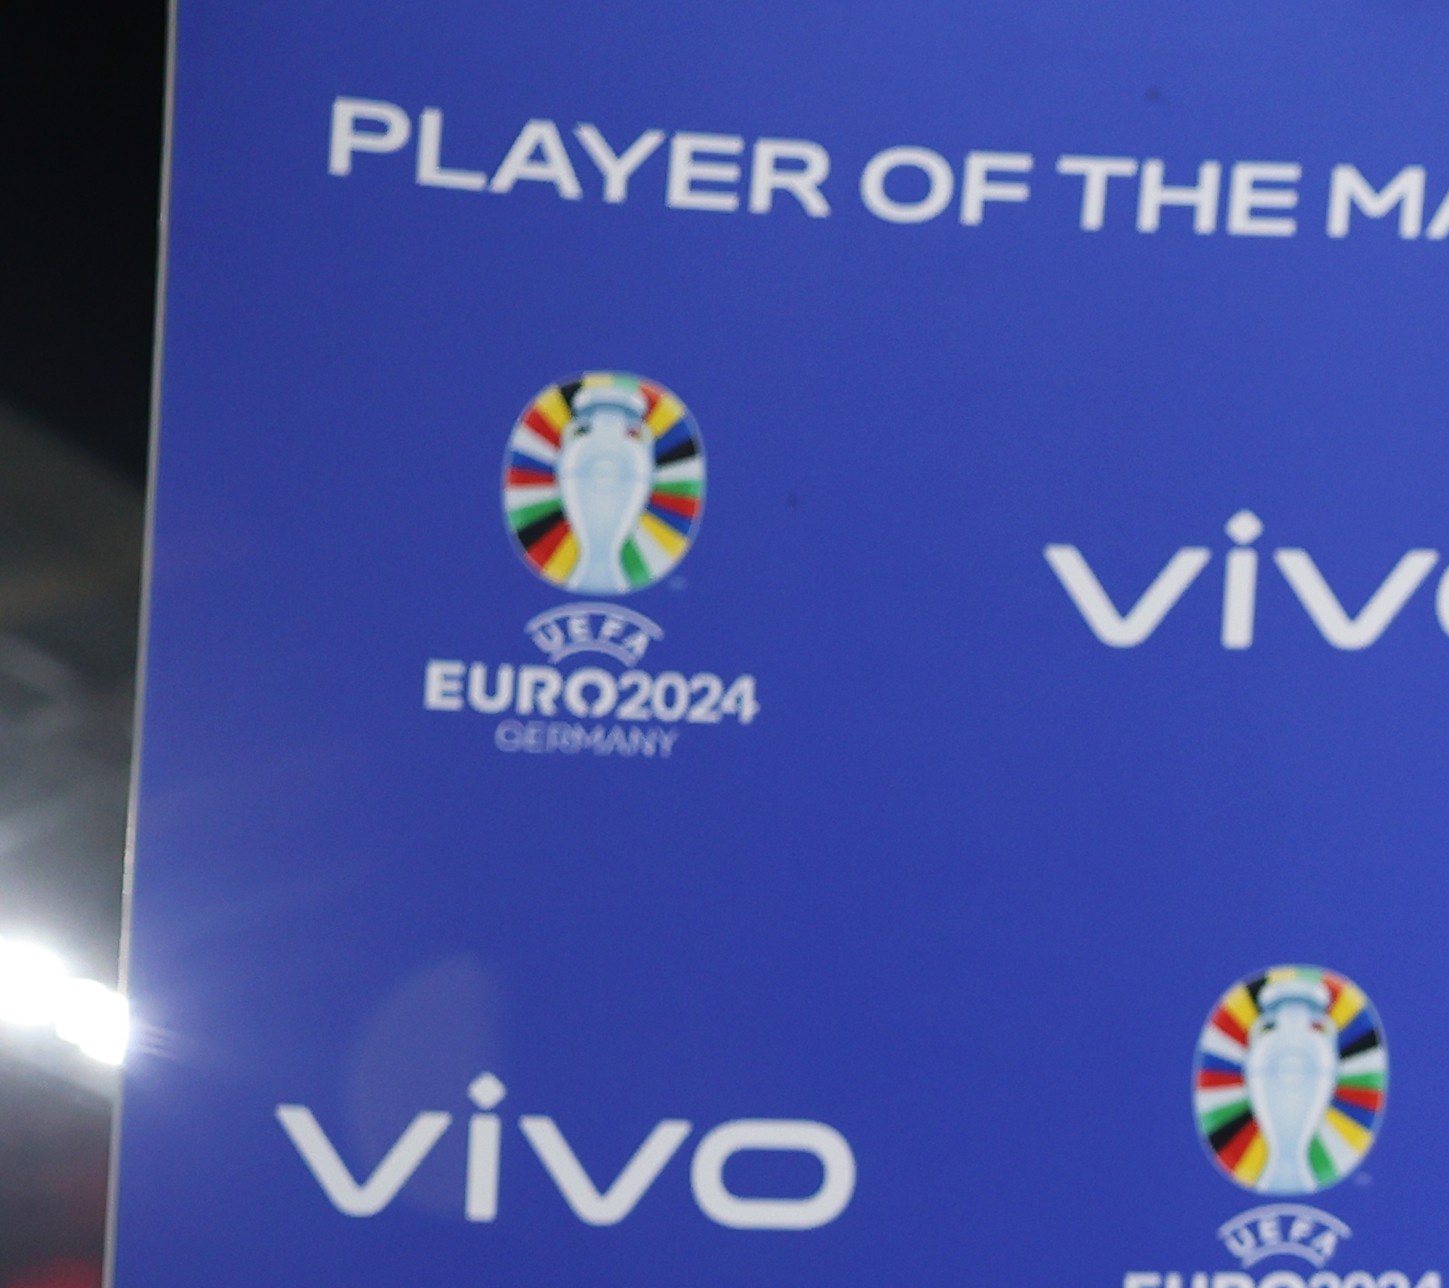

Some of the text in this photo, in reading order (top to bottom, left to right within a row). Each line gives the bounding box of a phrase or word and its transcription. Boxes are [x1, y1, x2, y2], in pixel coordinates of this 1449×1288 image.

[329, 97, 831, 218] PLAYER
[860, 146, 1034, 226] OF
[1056, 155, 1303, 237] THE
[531, 613, 650, 655] UEFA
[494, 720, 680, 757] GERMANY
[276, 1072, 858, 1230] vivo
[1224, 1217, 1339, 1259] UEFA
